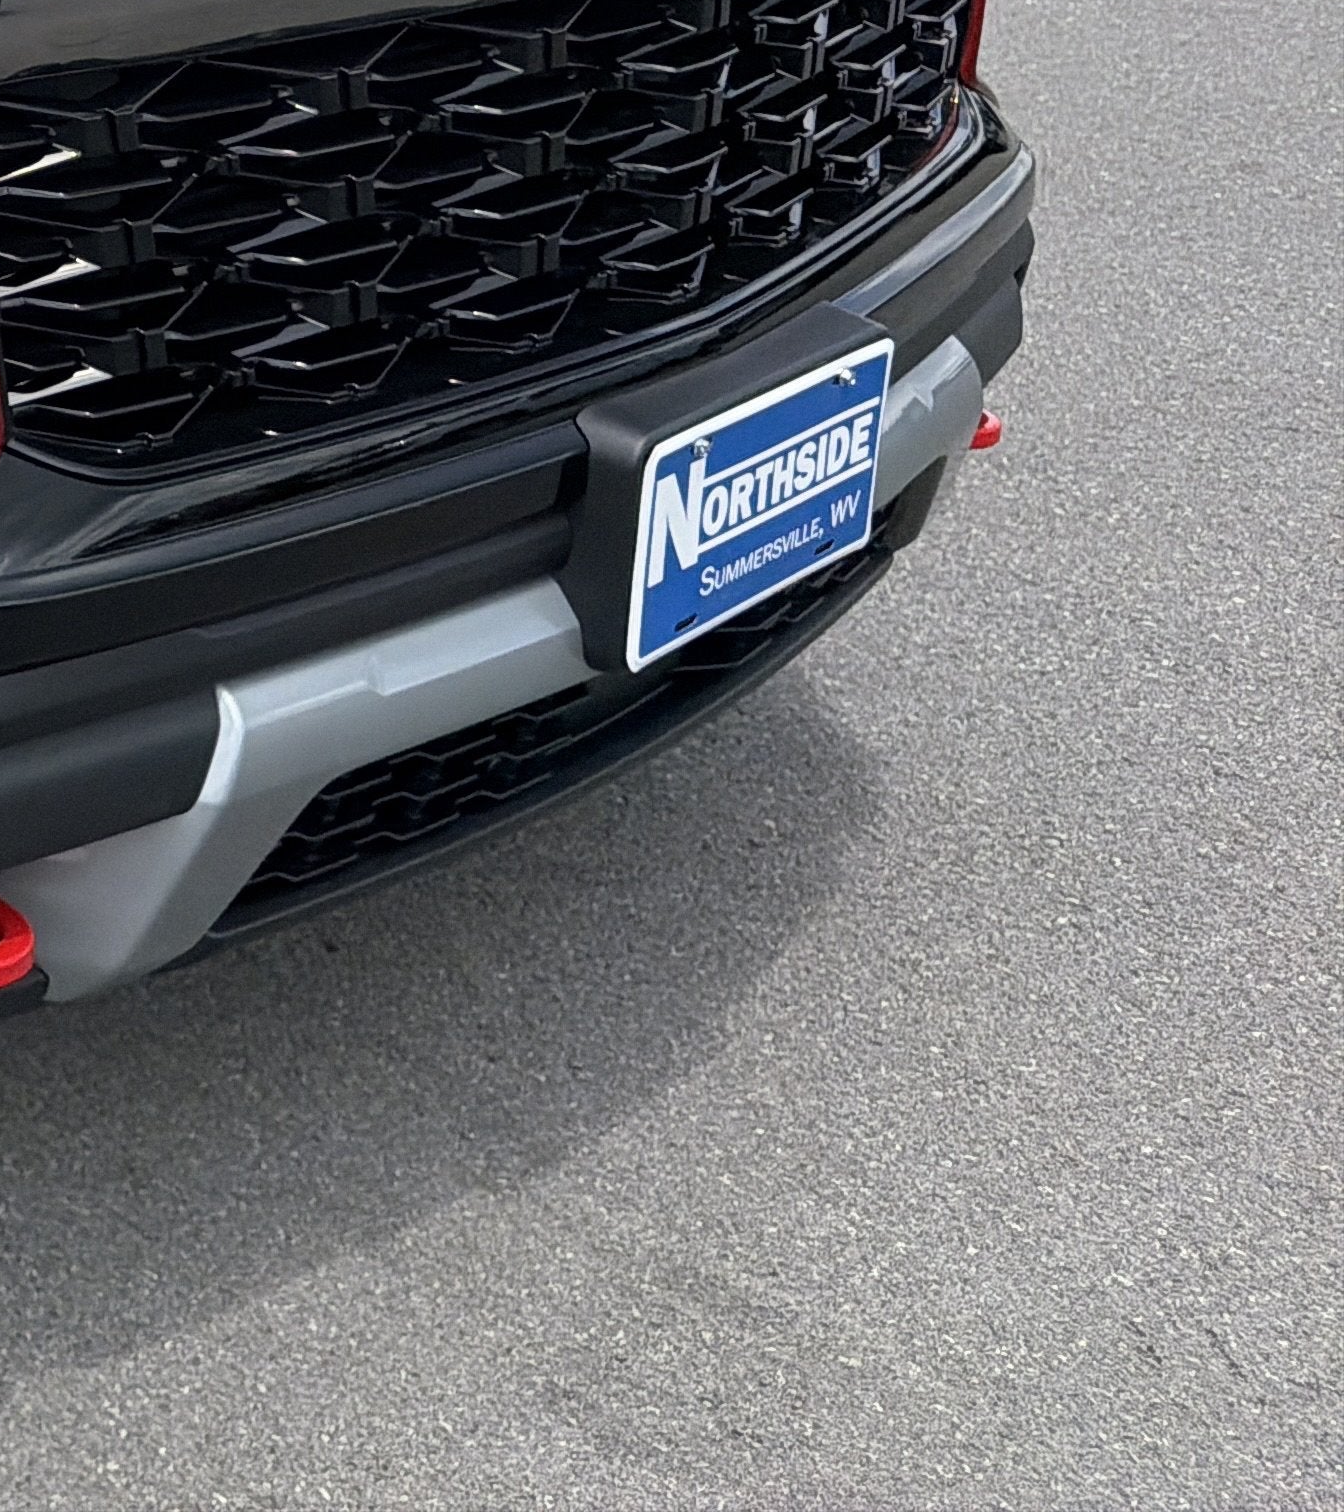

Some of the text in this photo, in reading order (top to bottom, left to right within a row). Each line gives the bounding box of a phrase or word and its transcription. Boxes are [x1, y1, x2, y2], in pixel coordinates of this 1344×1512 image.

[647, 411, 874, 588] NORTHSIDE
[699, 489, 862, 596] SUMMERSVILLE, WV
